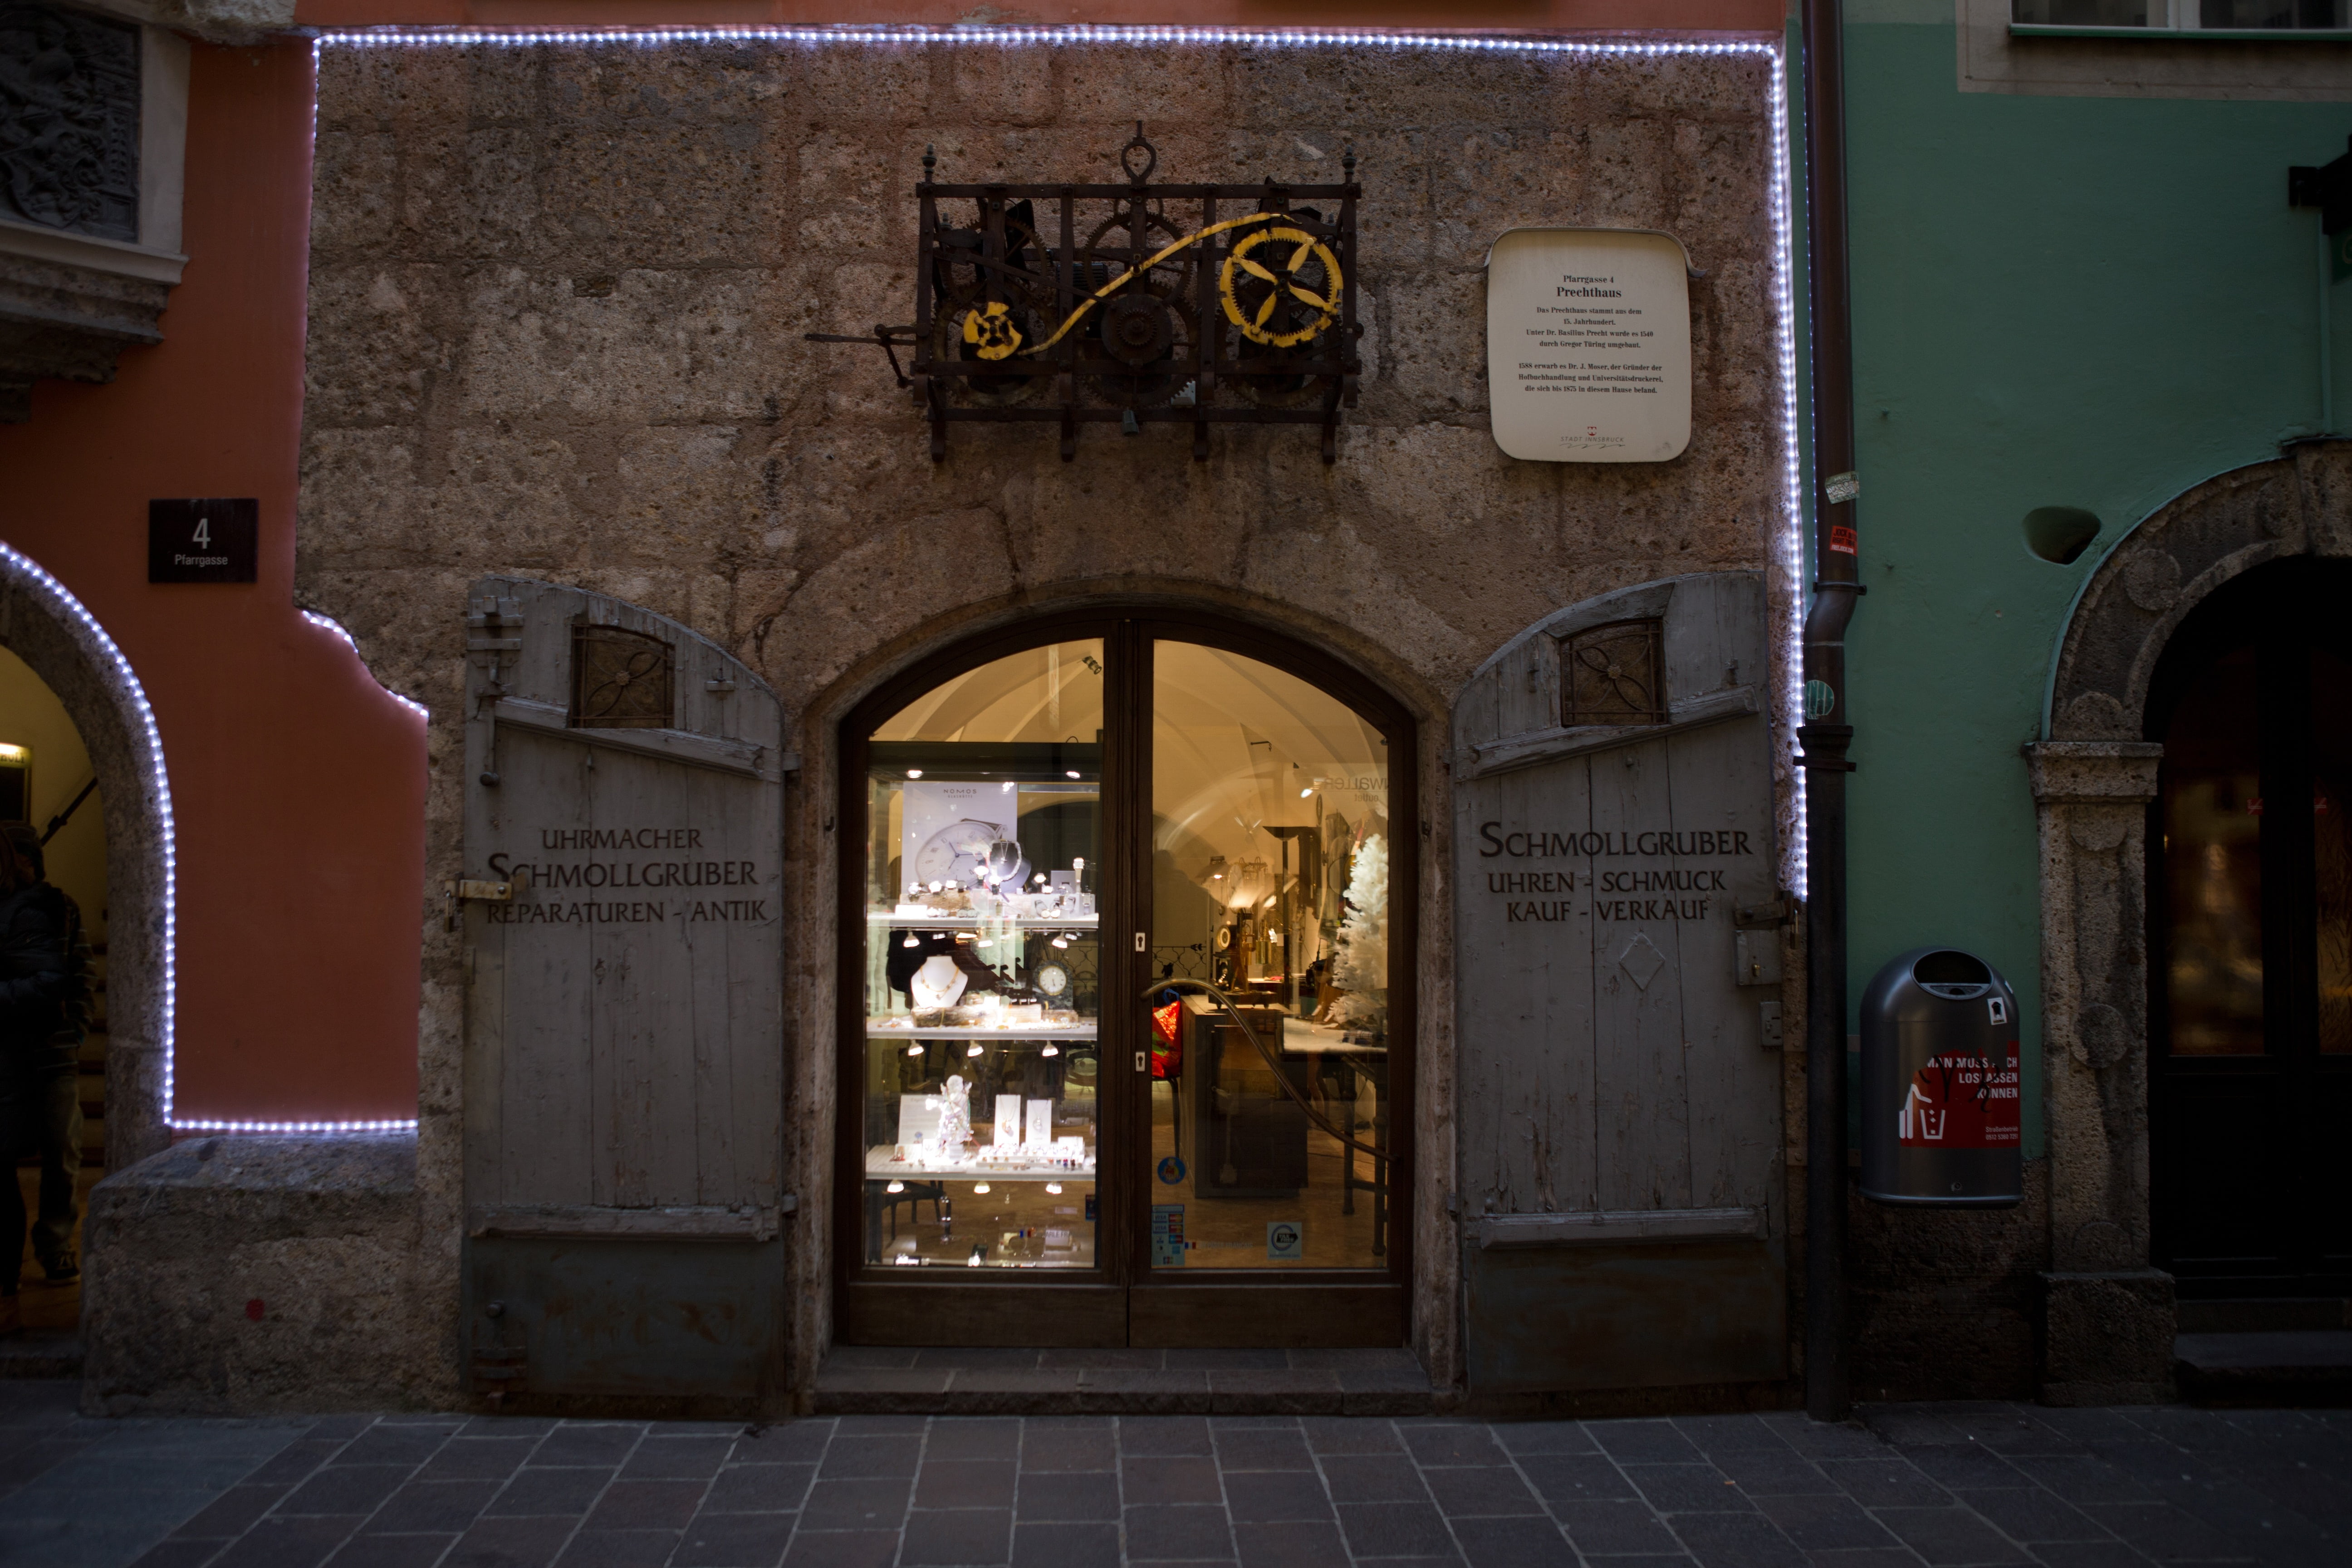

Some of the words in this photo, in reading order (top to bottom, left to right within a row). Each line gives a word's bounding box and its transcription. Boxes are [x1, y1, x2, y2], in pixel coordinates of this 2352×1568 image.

[1563, 275, 1607, 284] Pfarrgasse
[1557, 287, 1622, 298] Prechthaus
[1560, 341, 1582, 349] Gregor
[1519, 373, 1576, 382] Hofbuchhandlung
[1592, 375, 1663, 383] Universitätsdruckerei,
[192, 518, 211, 549] 4
[175, 554, 228, 567] Pfarrgasse
[542, 828, 704, 850] UHRMACHER
[1480, 822, 1753, 858] SCHMOLLGRUBER
[1488, 872, 1575, 894] UHREN
[1601, 870, 1727, 892] SCHMUCK
[487, 902, 664, 923] REPARATUREN
[692, 900, 768, 921] ANTIK
[1507, 901, 1571, 922] KAUF
[1596, 900, 1709, 921] VERKAUF
